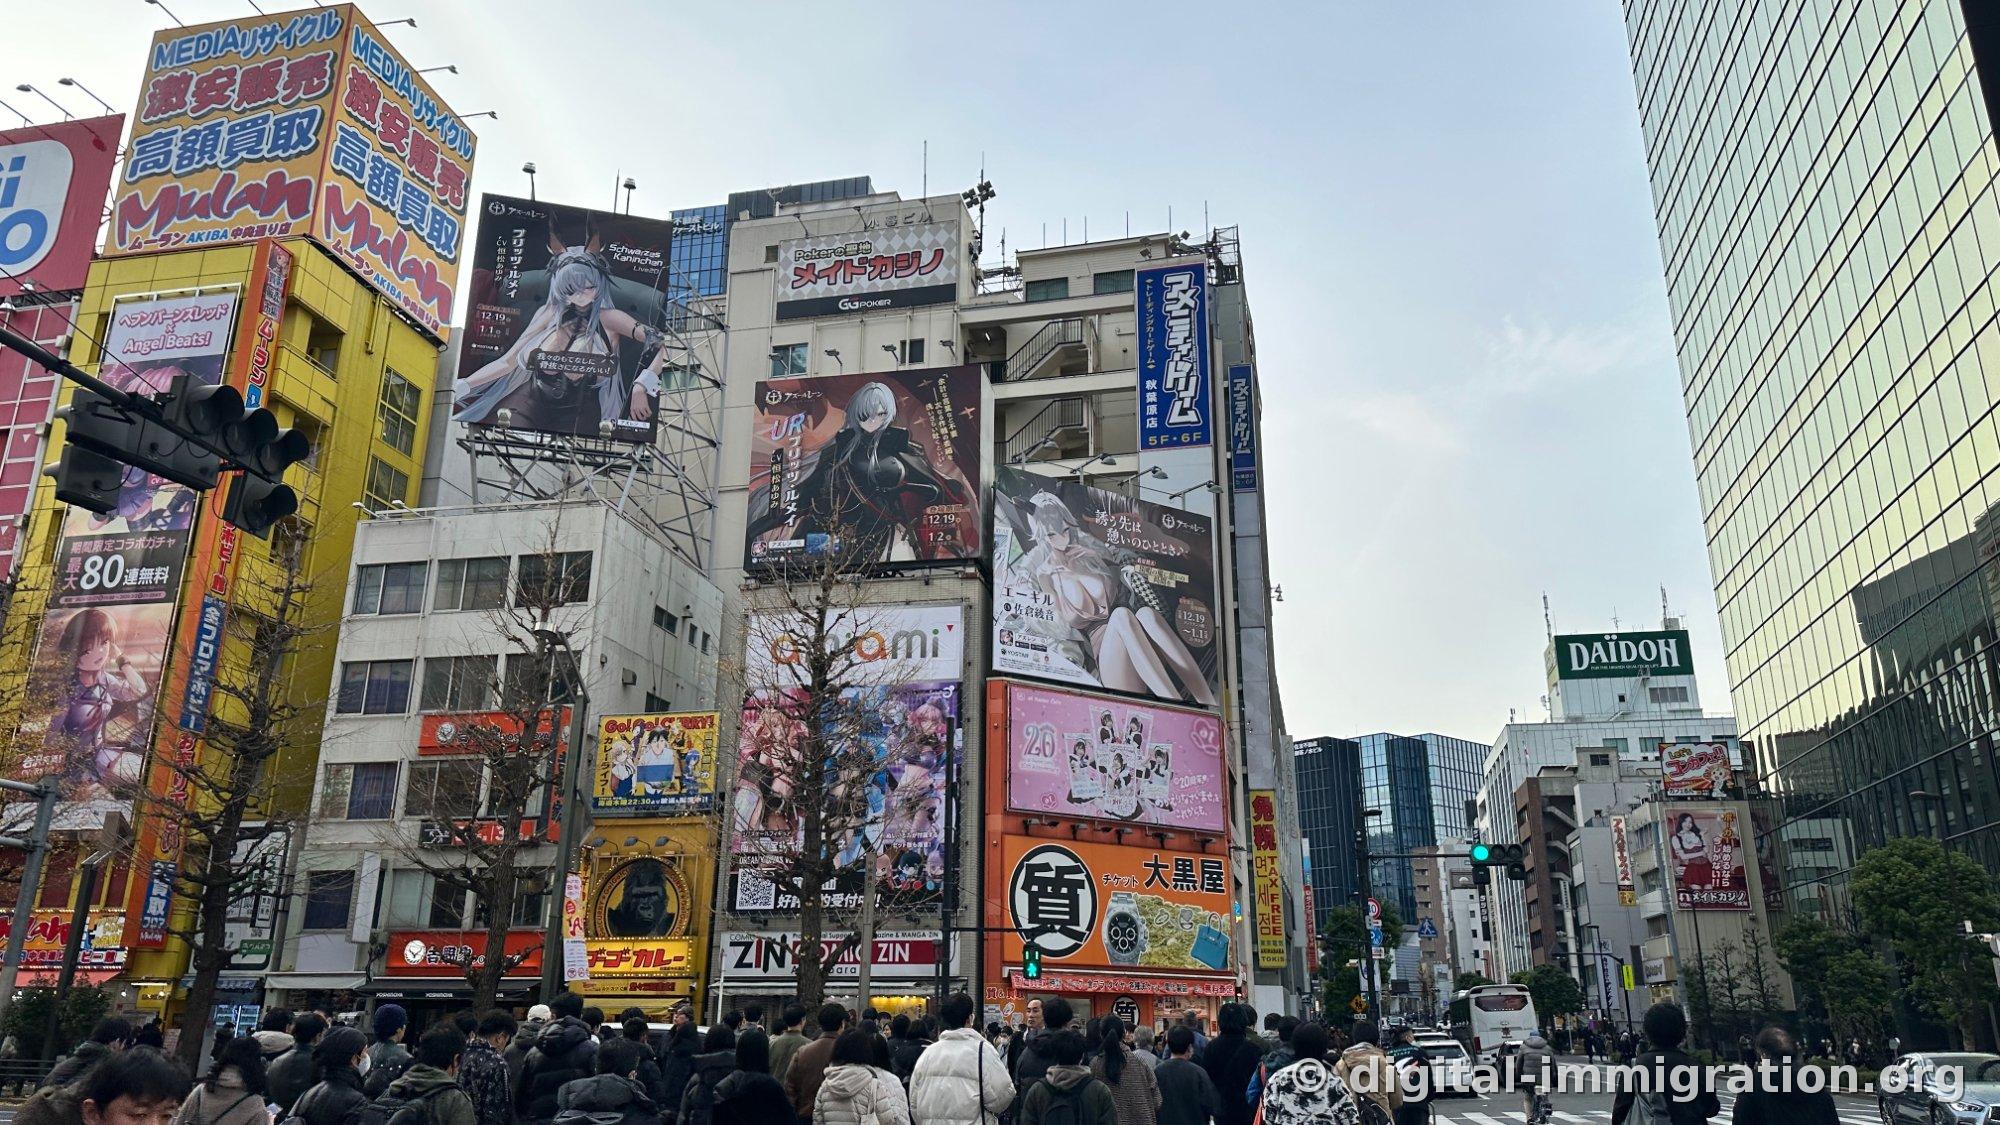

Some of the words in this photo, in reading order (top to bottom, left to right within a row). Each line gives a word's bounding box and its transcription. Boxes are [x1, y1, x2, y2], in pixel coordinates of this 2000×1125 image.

[152, 8, 345, 71] MEDIAリサイクル
[141, 49, 336, 123] 激安販売
[352, 26, 473, 160] MEDIAリサイクル
[125, 105, 324, 183] 高額買取
[343, 65, 468, 211] 激安販売
[116, 168, 316, 250] Mulan
[331, 122, 461, 264] 高額買取
[128, 232, 186, 251] ムーラン
[186, 228, 229, 243] AKIBA
[322, 182, 454, 325] Mulan
[609, 243, 661, 258] Schwarzes
[613, 252, 664, 267] Kaninchen
[794, 240, 872, 262] Pokerの聖地
[331, 238, 375, 277] ムーラン
[373, 272, 402, 302] AKIBA
[792, 248, 944, 289] メイドカジノ
[119, 303, 230, 329] ヘブンバーンスレッド
[122, 336, 165, 355] Angel
[166, 331, 213, 349] Beats!
[1145, 378, 1158, 429] 秋葉原店
[771, 411, 807, 441] UR
[1095, 509, 1142, 534] 誘う先は
[1102, 872, 1139, 889] チケット
[1142, 853, 1227, 895] 大黒屋
[1267, 855, 1279, 888] TAX
[1721, 844, 1733, 888] 始めるなら
[1021, 861, 1088, 944] 質
[1270, 893, 1283, 936] FREE
[1692, 890, 1746, 903] メイドカジノ
[877, 942, 909, 962] ZIN
